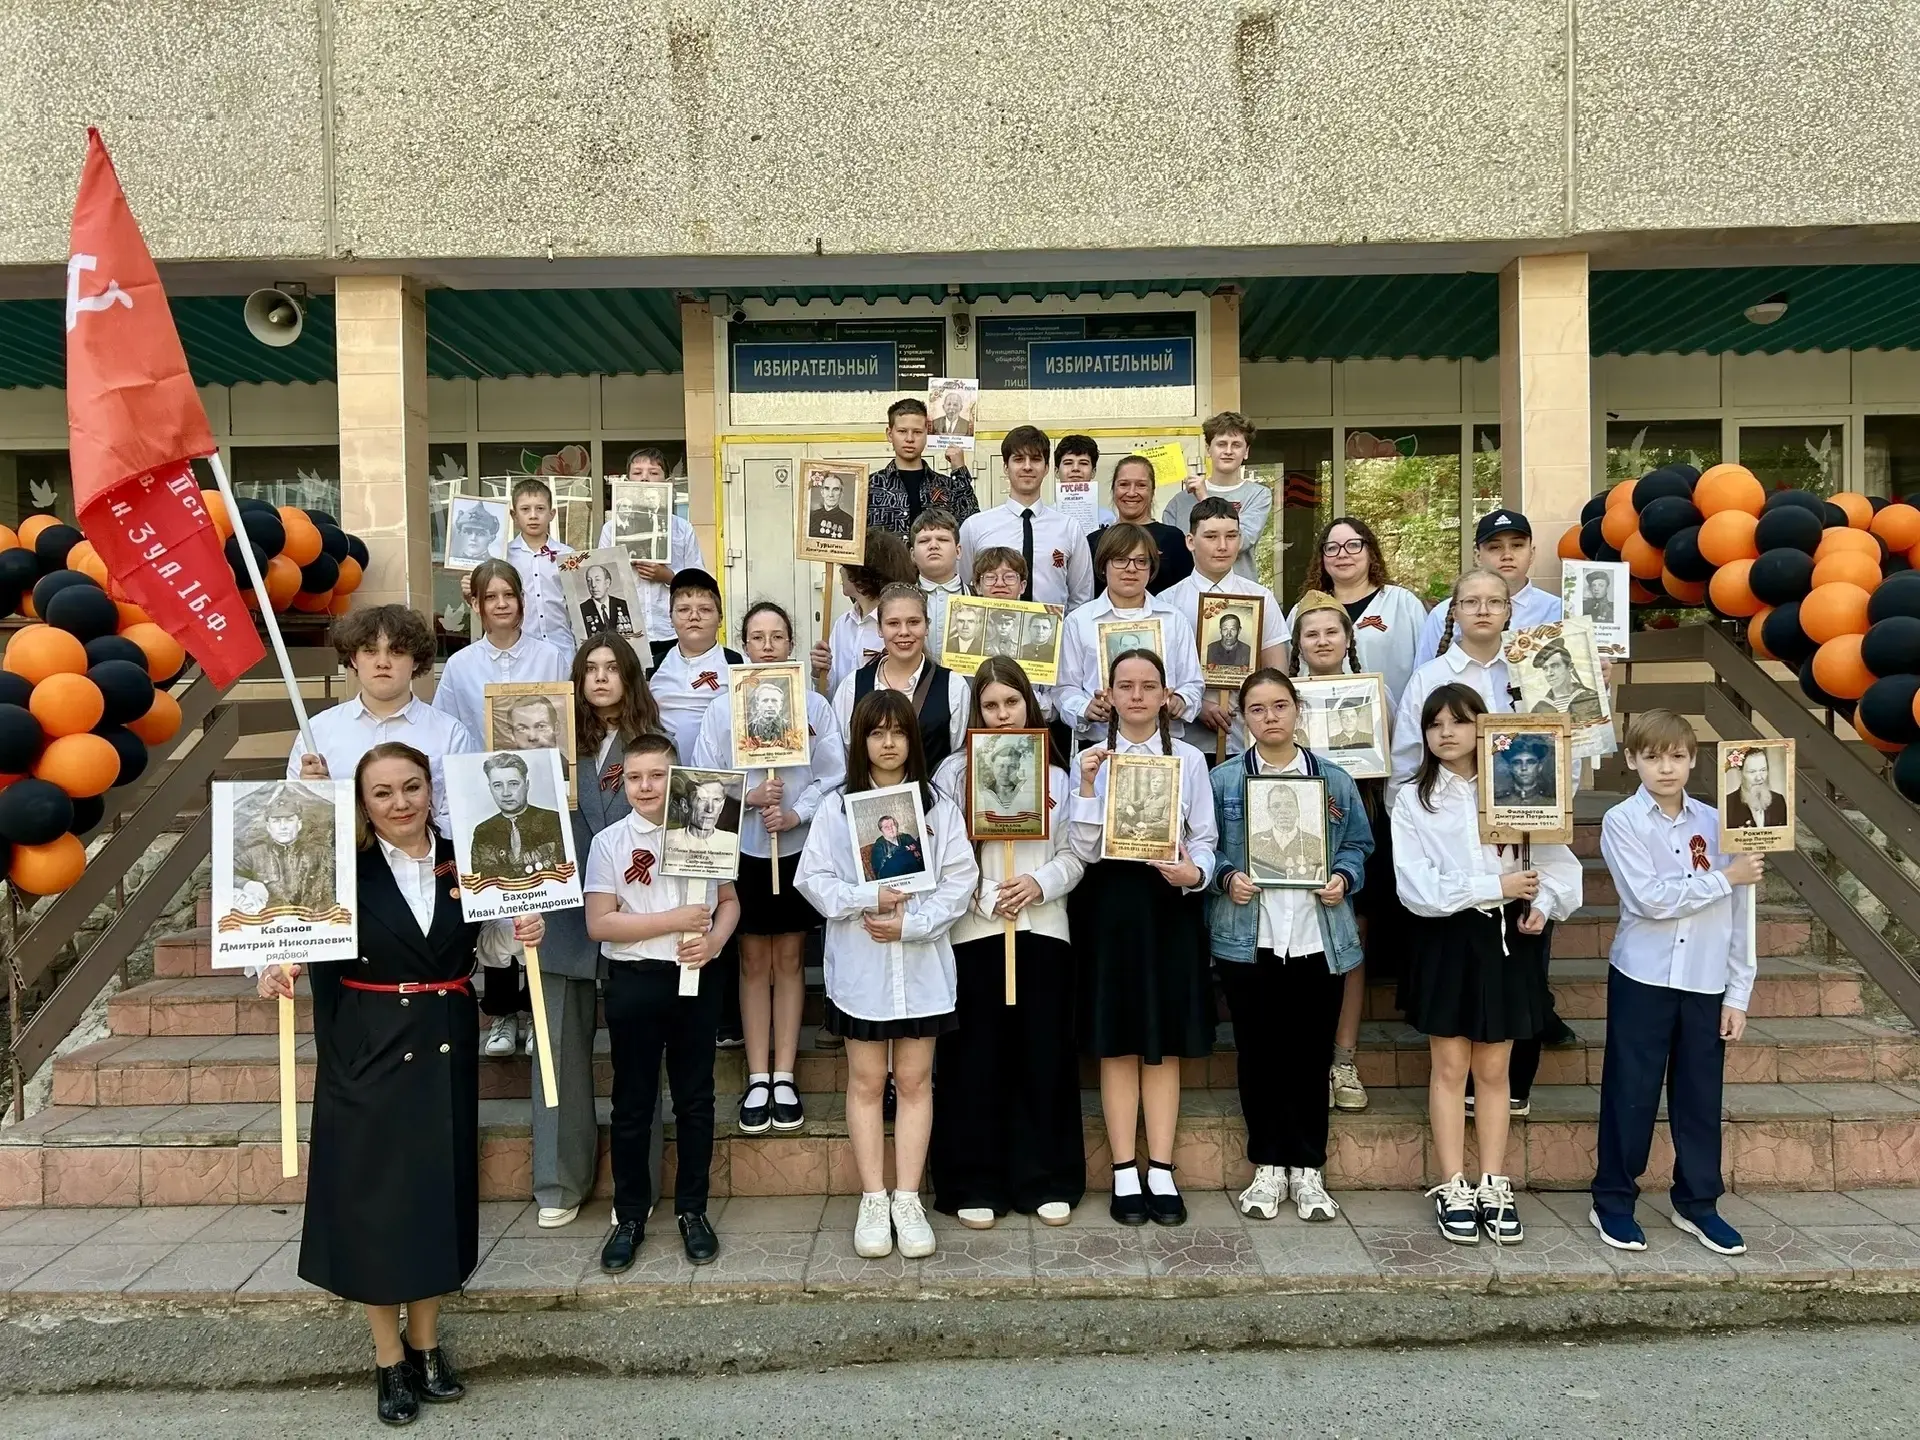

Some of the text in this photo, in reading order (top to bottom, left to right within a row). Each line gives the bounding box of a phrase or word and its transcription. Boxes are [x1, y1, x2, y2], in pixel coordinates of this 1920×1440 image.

[754, 354, 879, 377] ИЗБИРАТЕЛЬНЫЙ
[1045, 348, 1173, 374] ИЗБИРАТЕЛЬНЫЙ
[1004, 379, 1027, 388] ЛИЦЕ
[128, 521, 157, 545] 3
[502, 889, 547, 902] Бахорин
[468, 897, 580, 919] Иван Александрович
[260, 925, 312, 935] Кабанов
[219, 936, 352, 953] Дмитрий Николаевич
[266, 950, 309, 962] рядовой
